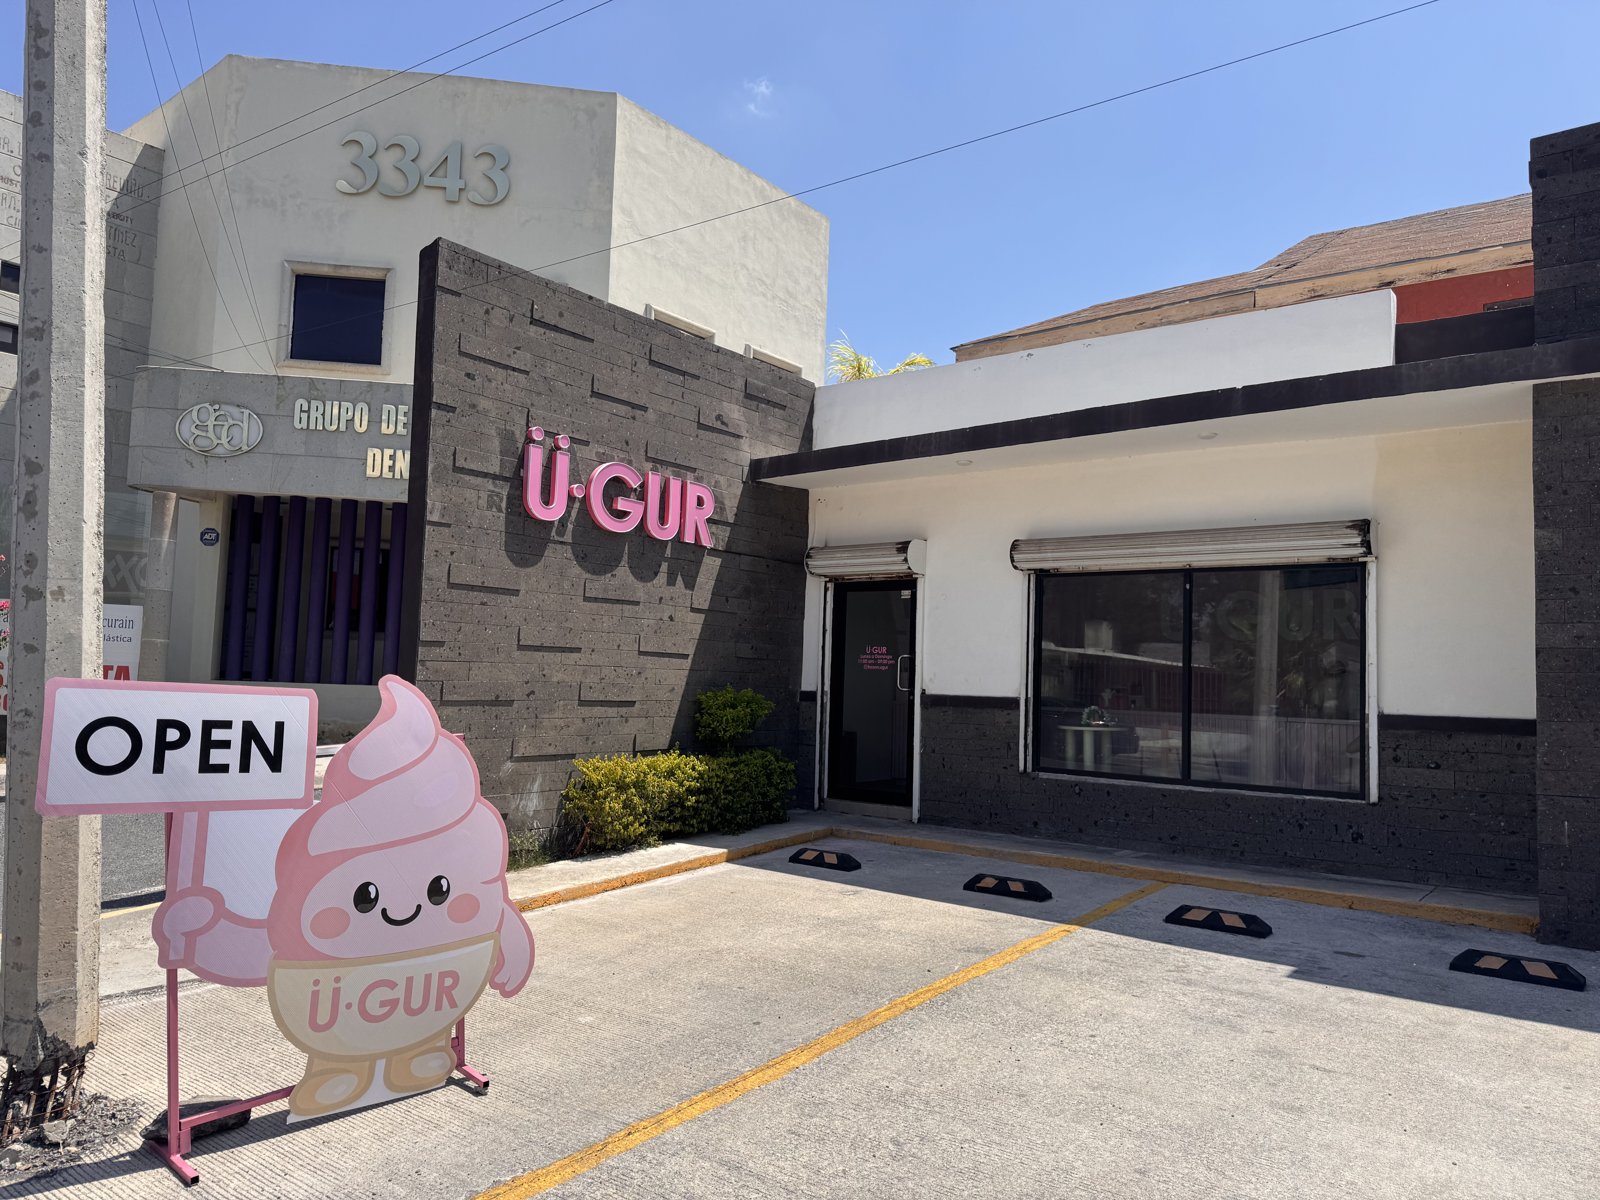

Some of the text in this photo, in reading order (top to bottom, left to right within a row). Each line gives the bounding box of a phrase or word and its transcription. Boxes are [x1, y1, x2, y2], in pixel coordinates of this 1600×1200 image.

[335, 130, 511, 206] 3343
[293, 398, 409, 436] GRUPO DE
[202, 532, 217, 541] ADT
[75, 716, 285, 776] OPEN
